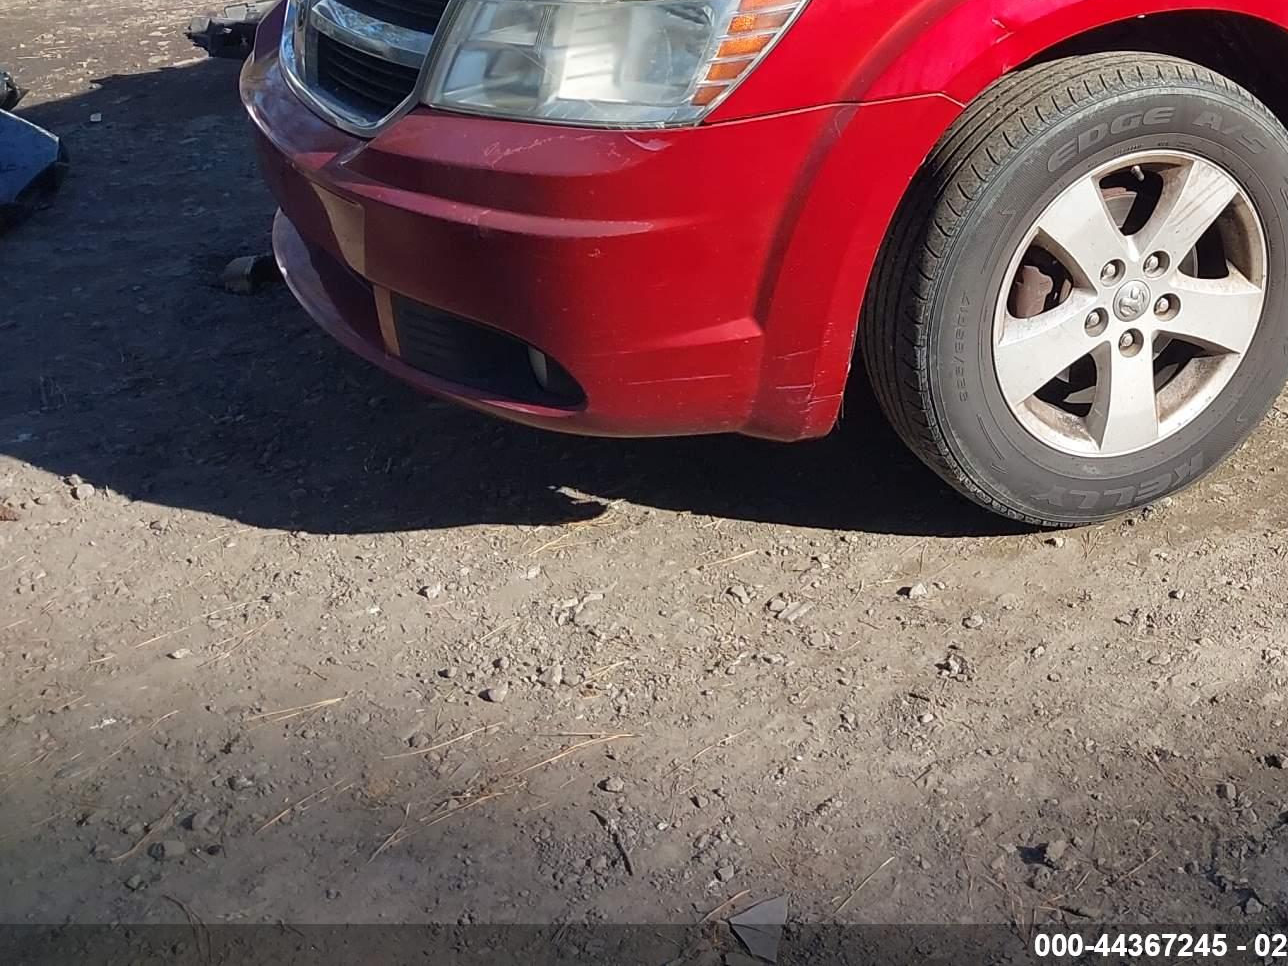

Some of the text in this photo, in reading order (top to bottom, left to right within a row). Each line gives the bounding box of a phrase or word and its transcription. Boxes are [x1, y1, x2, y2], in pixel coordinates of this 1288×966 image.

[1048, 106, 1267, 172] EDGE A/S
[1030, 451, 1204, 509] KELLY
